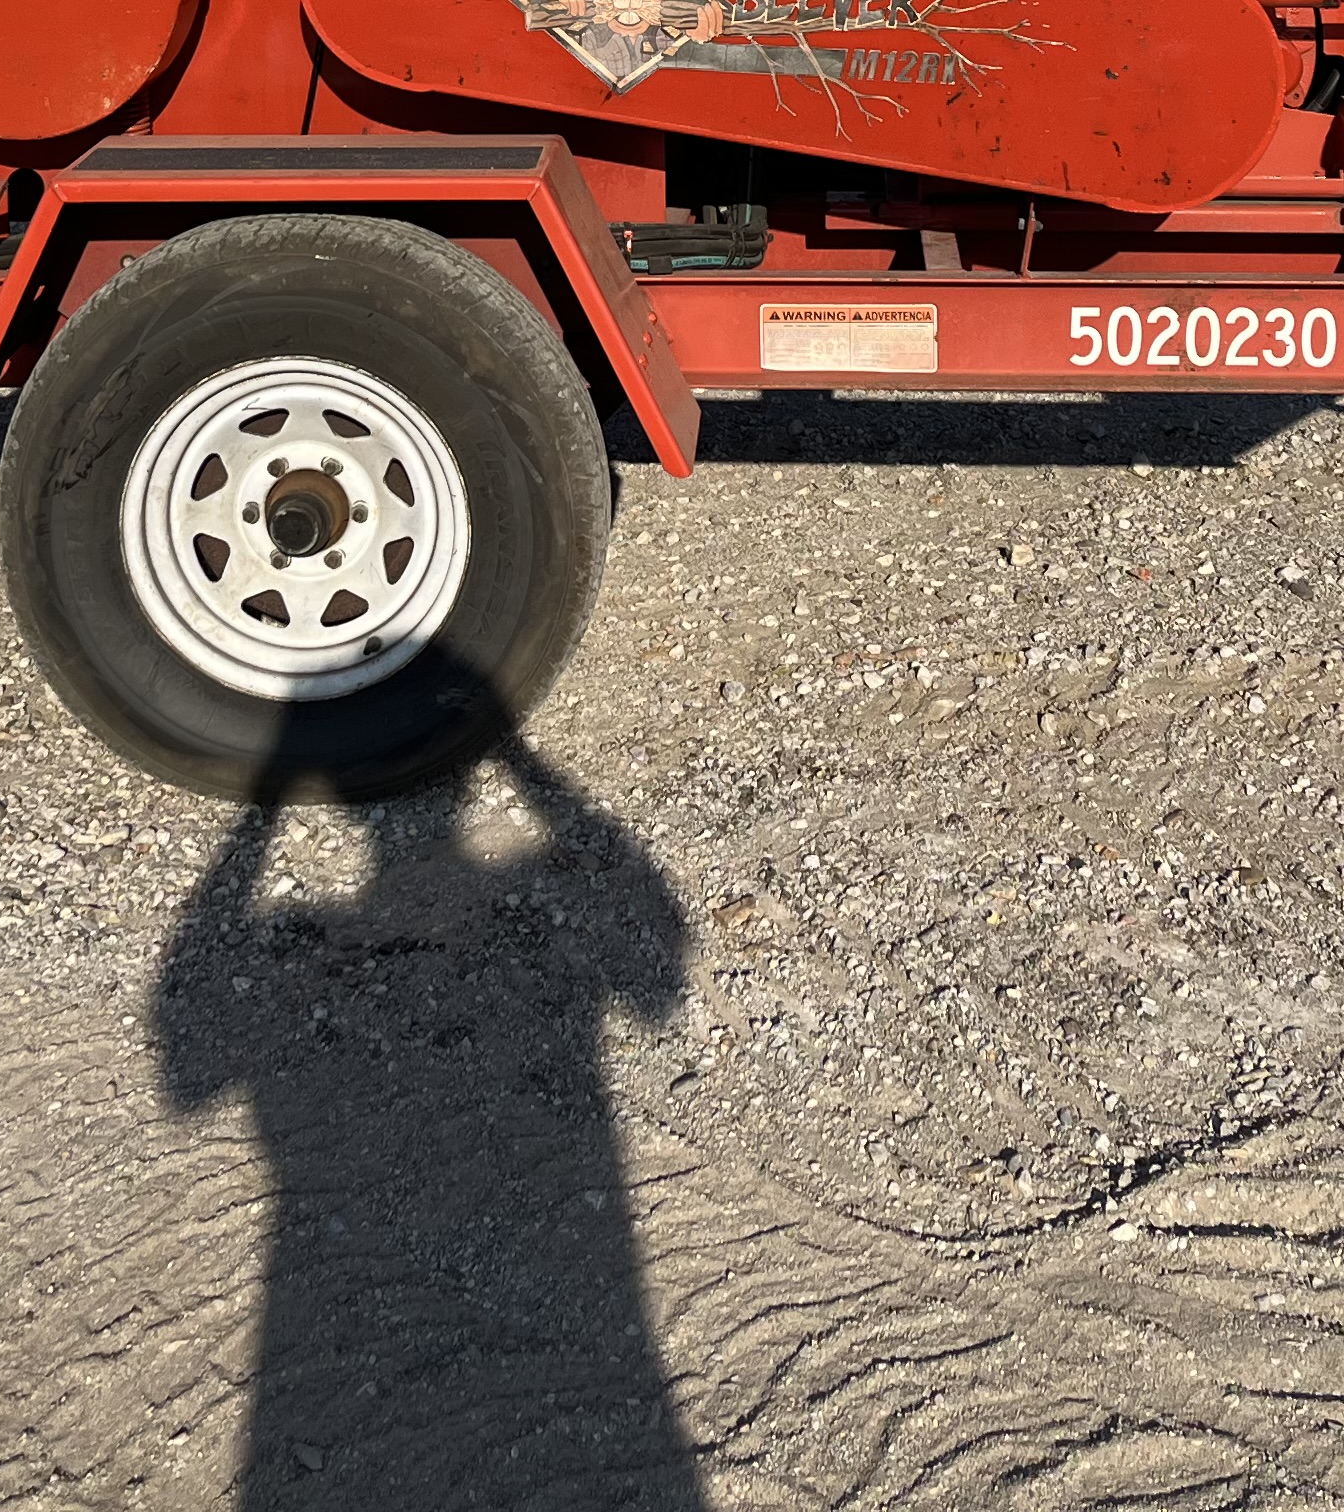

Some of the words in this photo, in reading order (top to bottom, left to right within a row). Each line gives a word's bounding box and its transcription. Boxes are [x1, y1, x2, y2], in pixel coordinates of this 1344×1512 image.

[782, 310, 847, 321] WARNING
[864, 310, 932, 322] ADVERTENCIA
[1069, 306, 1337, 367] 5020230
